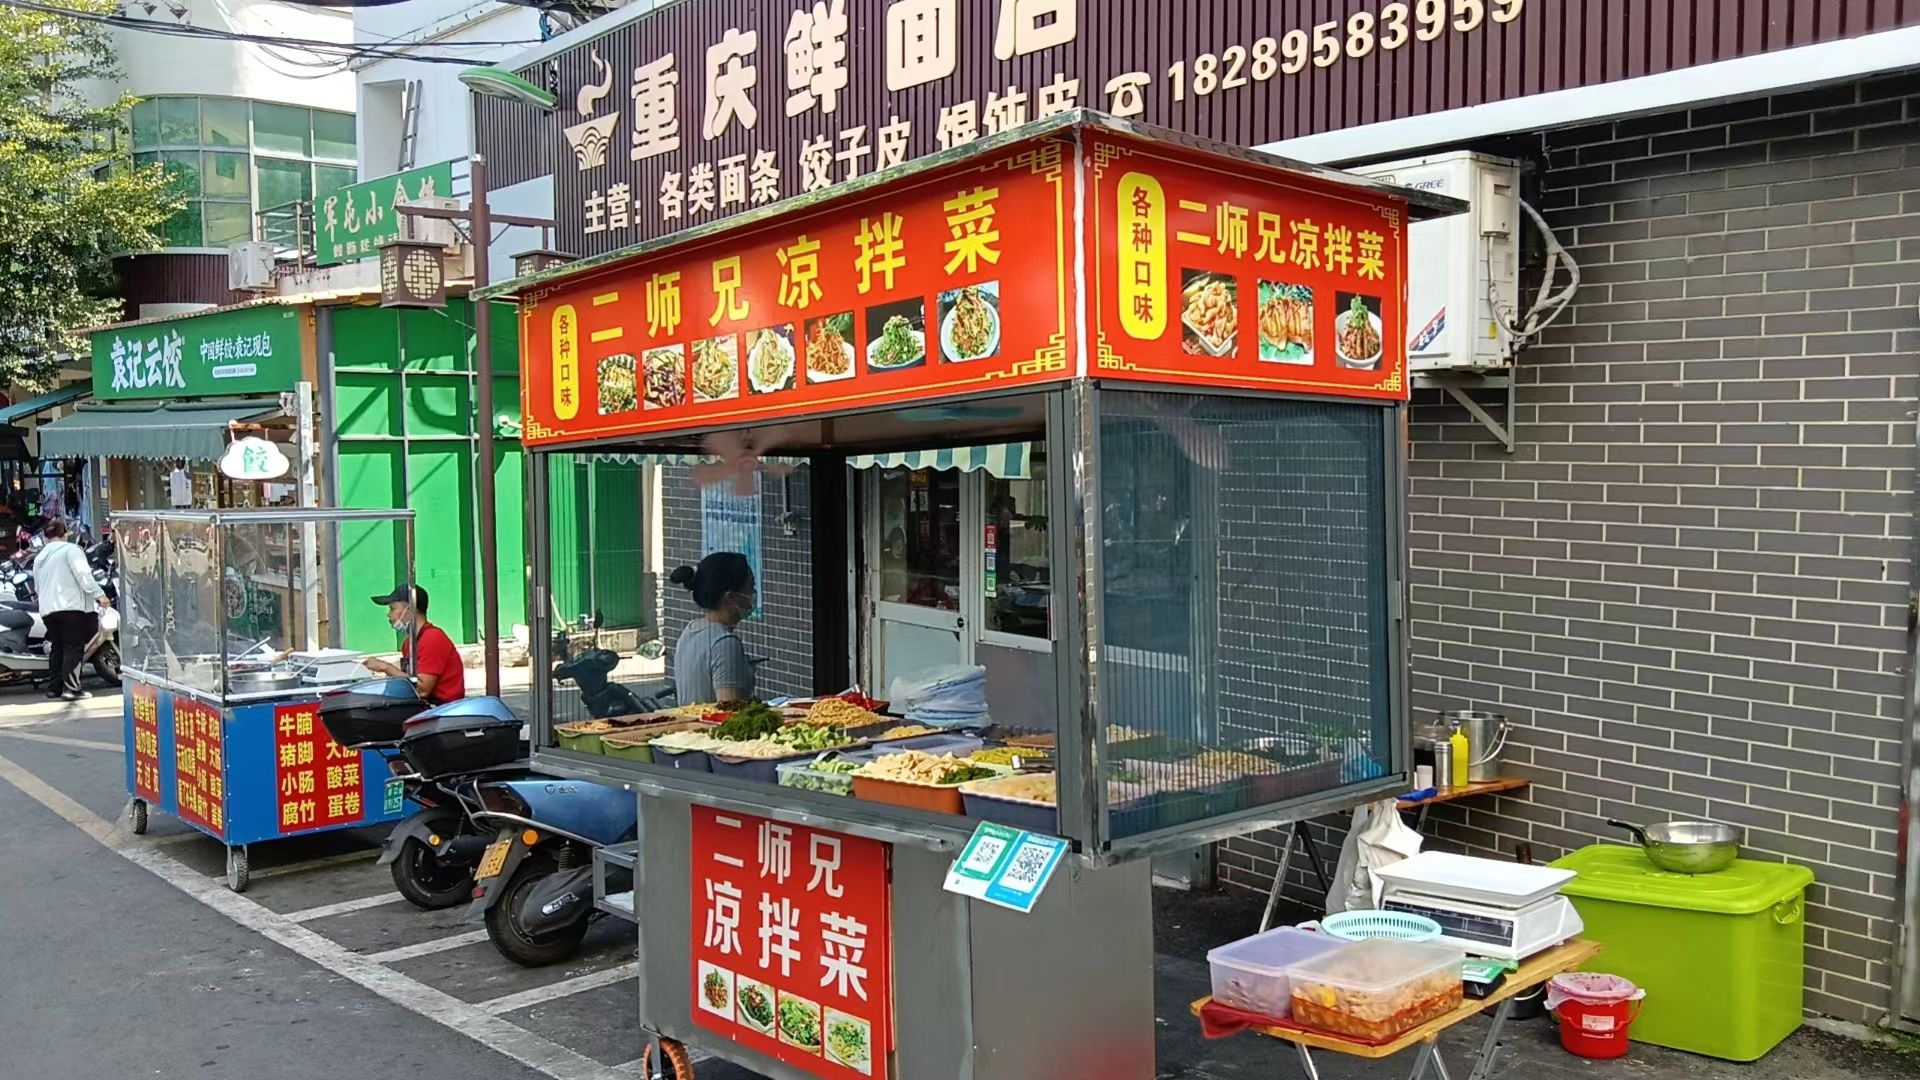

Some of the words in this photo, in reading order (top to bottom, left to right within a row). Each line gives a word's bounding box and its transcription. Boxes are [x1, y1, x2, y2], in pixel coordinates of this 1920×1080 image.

[799, 116, 911, 192] 饺子皮
[1414, 178, 1444, 190] GREE
[591, 187, 1001, 343] 二师兄凉拌菜
[1131, 185, 1154, 324] 各种口味
[1176, 199, 1386, 281] 二师兄凉拌菜
[110, 329, 186, 393] 袁记云饺
[557, 313, 572, 407] 各种口味
[279, 711, 313, 737] 牛腩
[280, 741, 314, 767] 猪脚
[281, 770, 315, 796] 小肠
[326, 763, 360, 789] 酸菜
[282, 799, 316, 826] 腐竹
[327, 792, 360, 818] 蛋卷
[713, 815, 844, 898] 二师兄
[704, 878, 868, 1001] 凉拌菜
